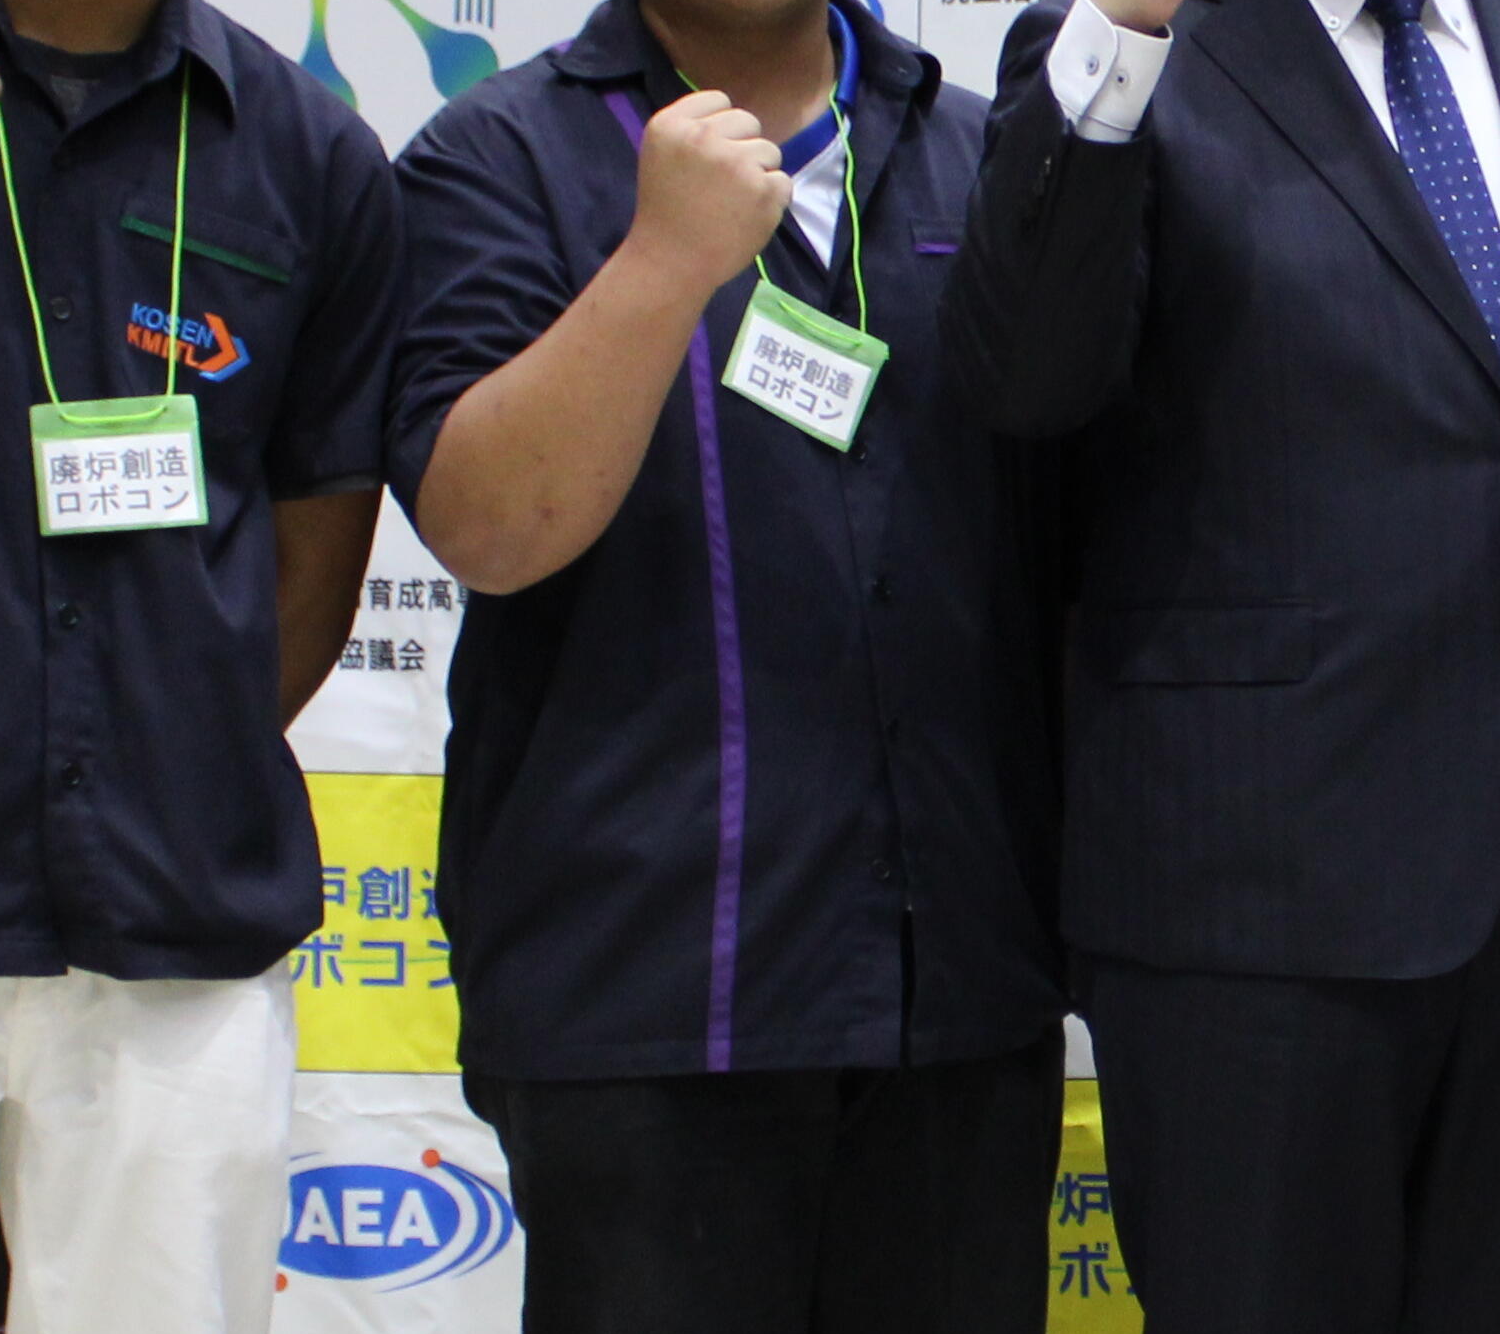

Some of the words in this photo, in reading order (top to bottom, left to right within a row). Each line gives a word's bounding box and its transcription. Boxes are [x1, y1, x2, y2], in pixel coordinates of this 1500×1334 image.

[131, 302, 215, 349] KOSEN
[754, 333, 854, 399] 廃炉創造
[748, 363, 843, 420] ロボコン
[50, 446, 189, 485] 廃炉創造
[56, 485, 190, 516] ロボコン
